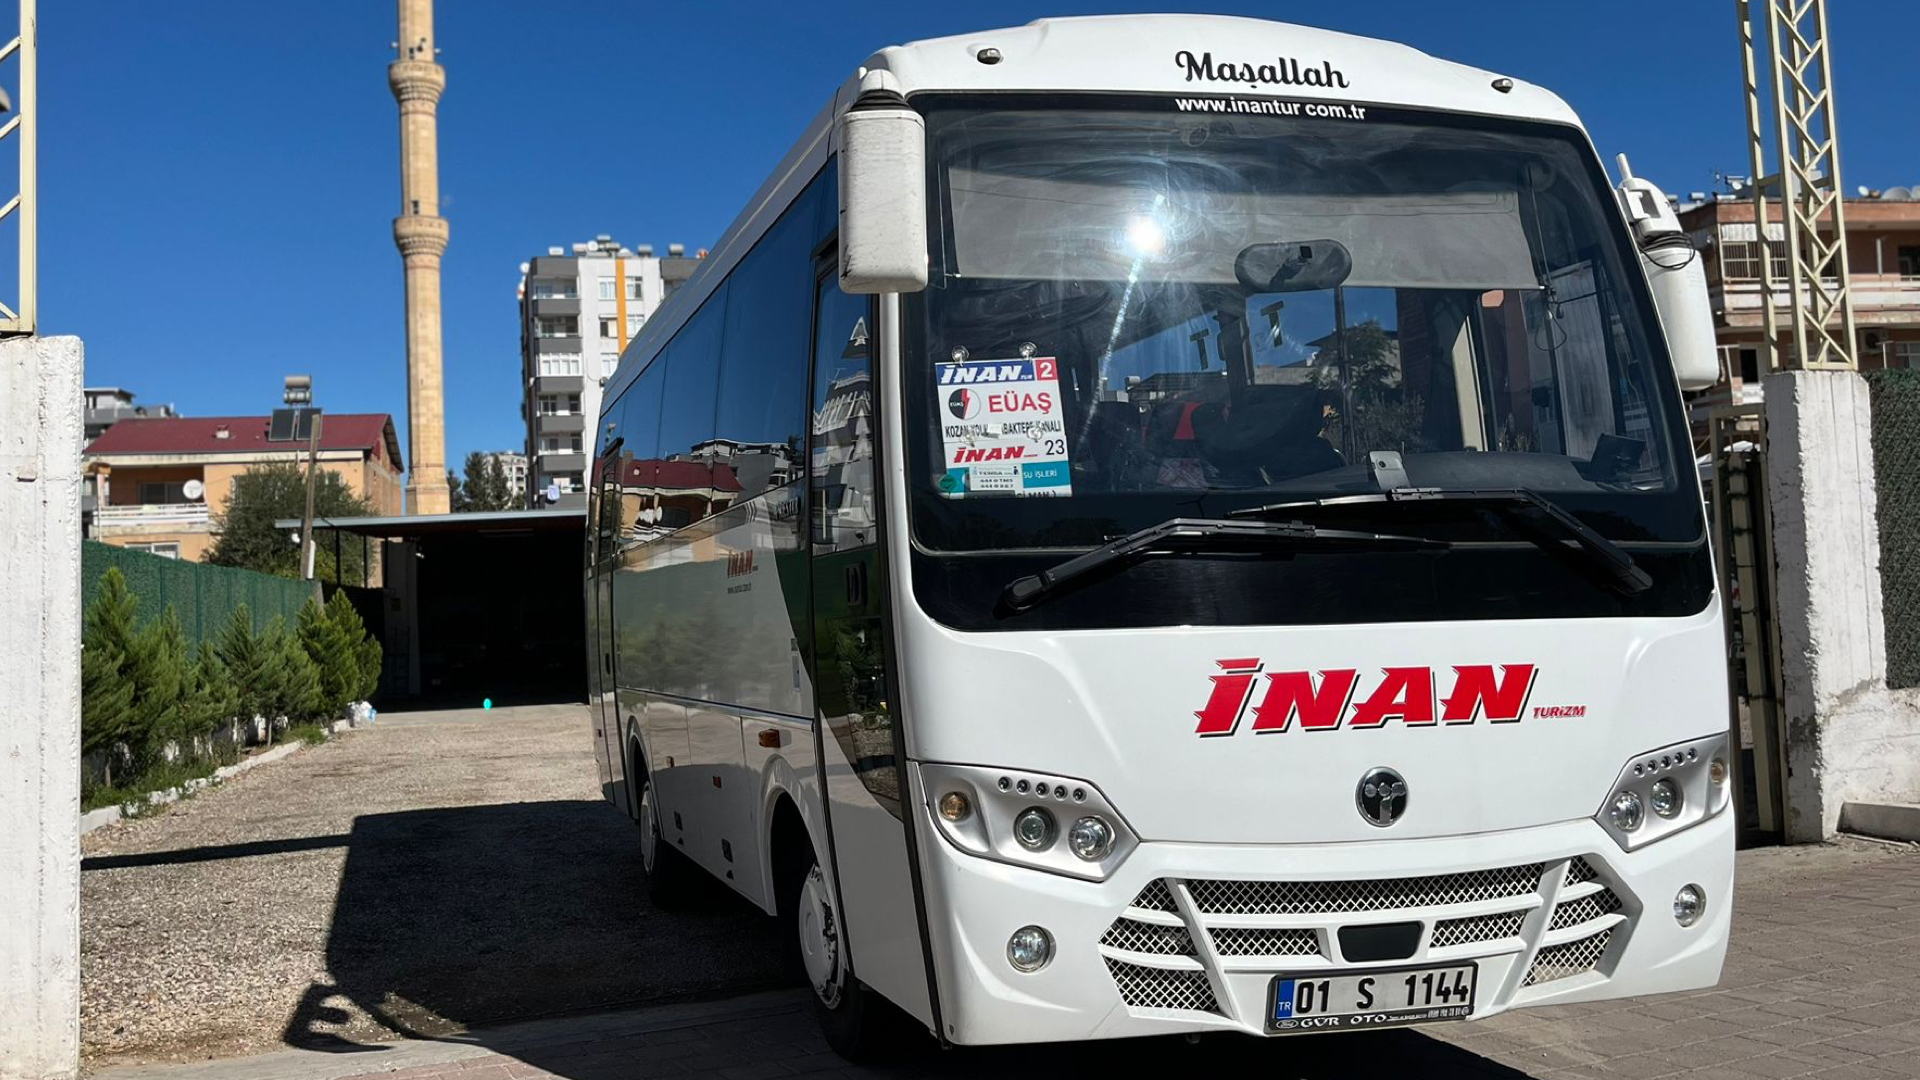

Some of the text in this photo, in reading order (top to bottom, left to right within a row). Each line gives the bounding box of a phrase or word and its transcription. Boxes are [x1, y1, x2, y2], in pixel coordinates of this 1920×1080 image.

[1175, 50, 1350, 88] Maşallah
[940, 364, 1024, 384] İNAN
[1040, 362, 1053, 378] 2
[988, 390, 1052, 415] EÜAŞ
[954, 446, 1025, 463] İNAN
[1044, 439, 1065, 456] 23
[1193, 657, 1539, 738] İNAN
[1296, 970, 1469, 1014] 01 S 1144
[1279, 1001, 1291, 1011] TR
[1350, 1014, 1387, 1024] OTO
